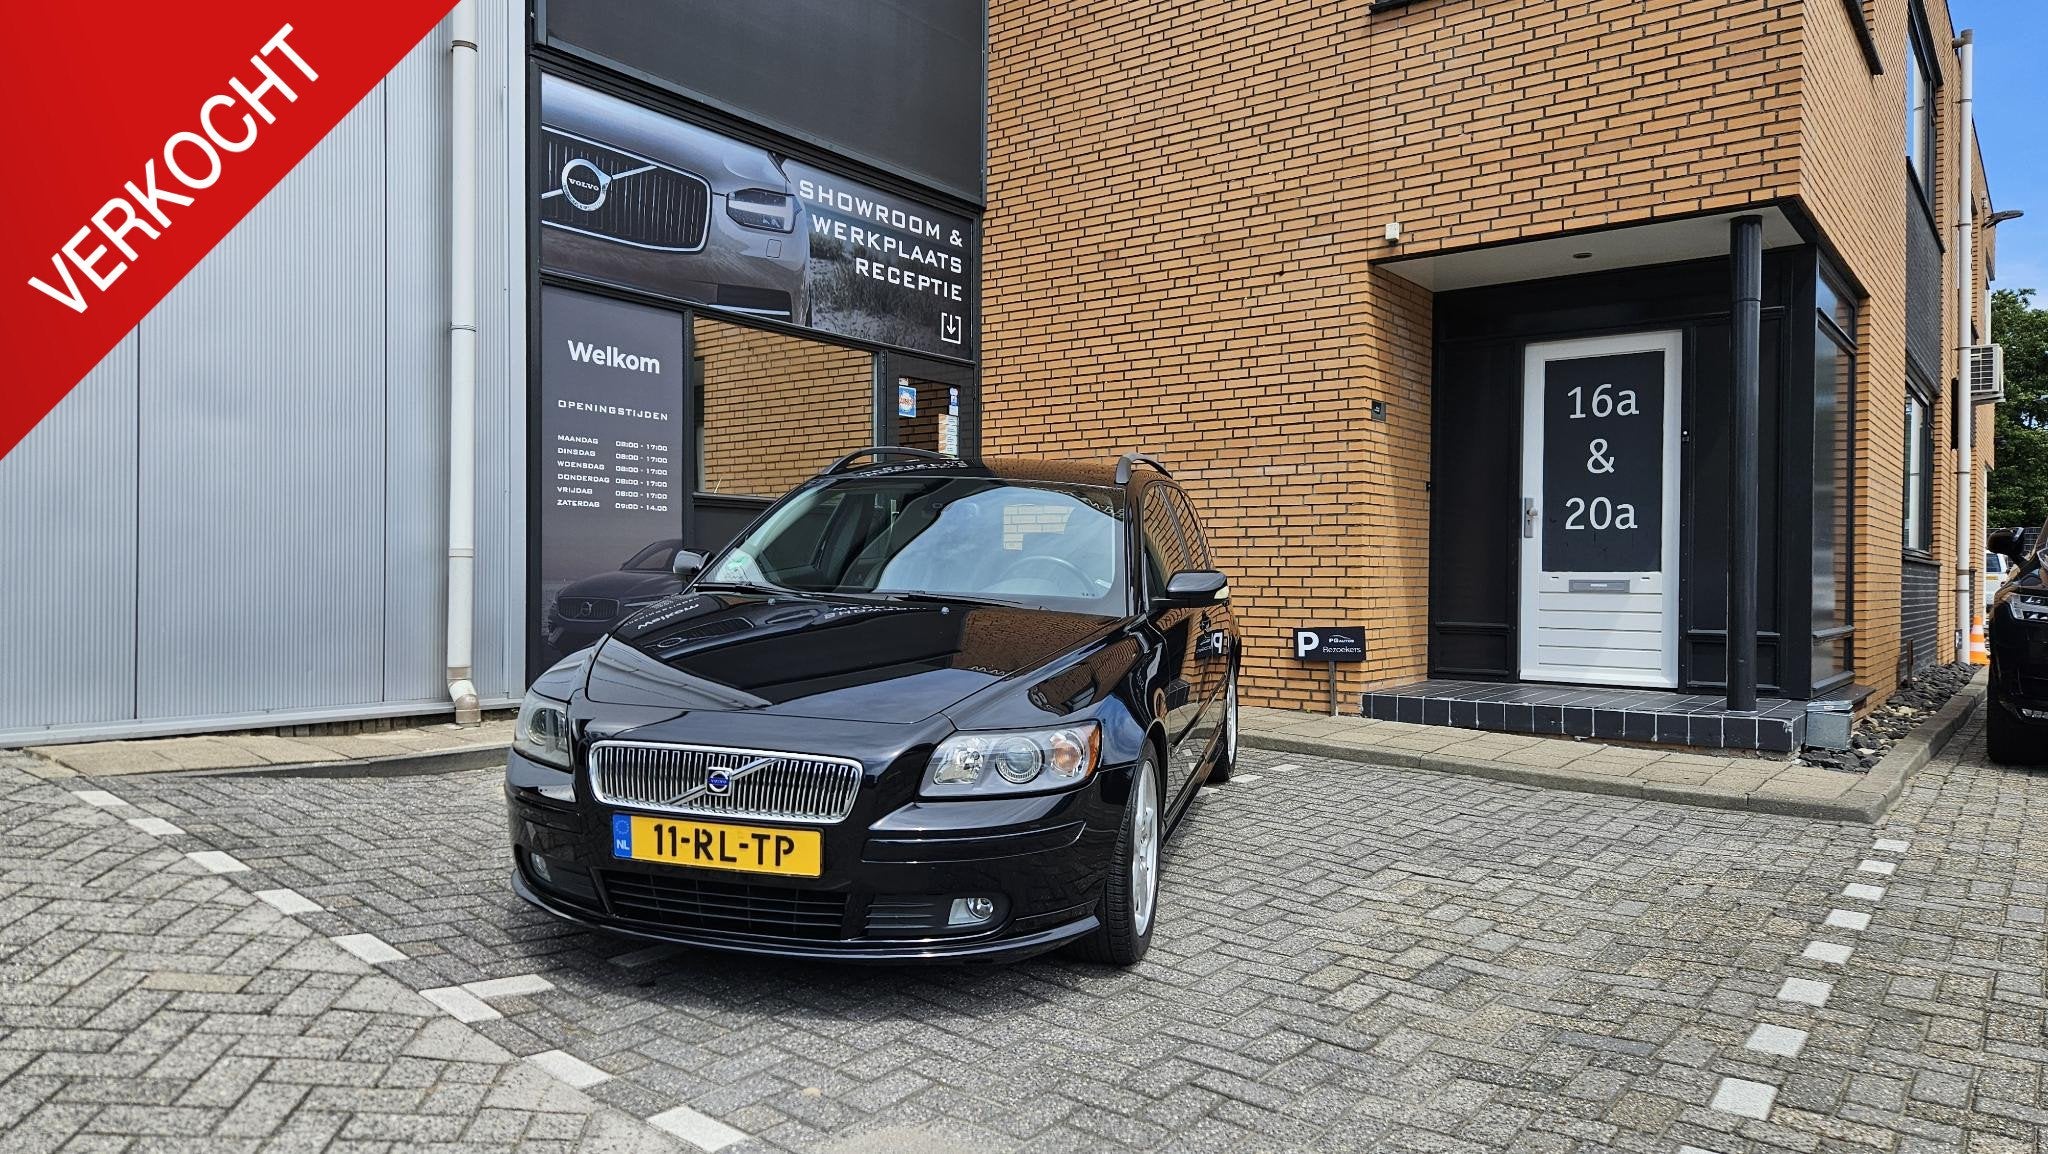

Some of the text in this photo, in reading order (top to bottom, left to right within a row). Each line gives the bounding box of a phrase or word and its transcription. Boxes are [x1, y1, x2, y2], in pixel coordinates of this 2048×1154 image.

[568, 177, 600, 192] VOLVO
[799, 180, 963, 247] SHOWROOM &
[812, 214, 963, 274] WERKPLAATS
[855, 256, 963, 302] RECEPTIE
[567, 339, 661, 374] Welkom
[558, 400, 668, 421] OPENINGSTIJDEN
[1567, 383, 1640, 419] 16a
[557, 435, 599, 445] MAANDAG
[557, 447, 596, 457] DINSDAG
[1586, 438, 1615, 474] &
[557, 460, 605, 470] WOENSDAG
[557, 473, 610, 484] DONDERDAG
[557, 486, 593, 495] VRIJDAG
[556, 499, 600, 508] ZATERDAG
[1565, 496, 1638, 530] 20a
[1297, 631, 1320, 657] P
[616, 840, 630, 851] NL
[654, 823, 795, 867] 11-RL-TP
